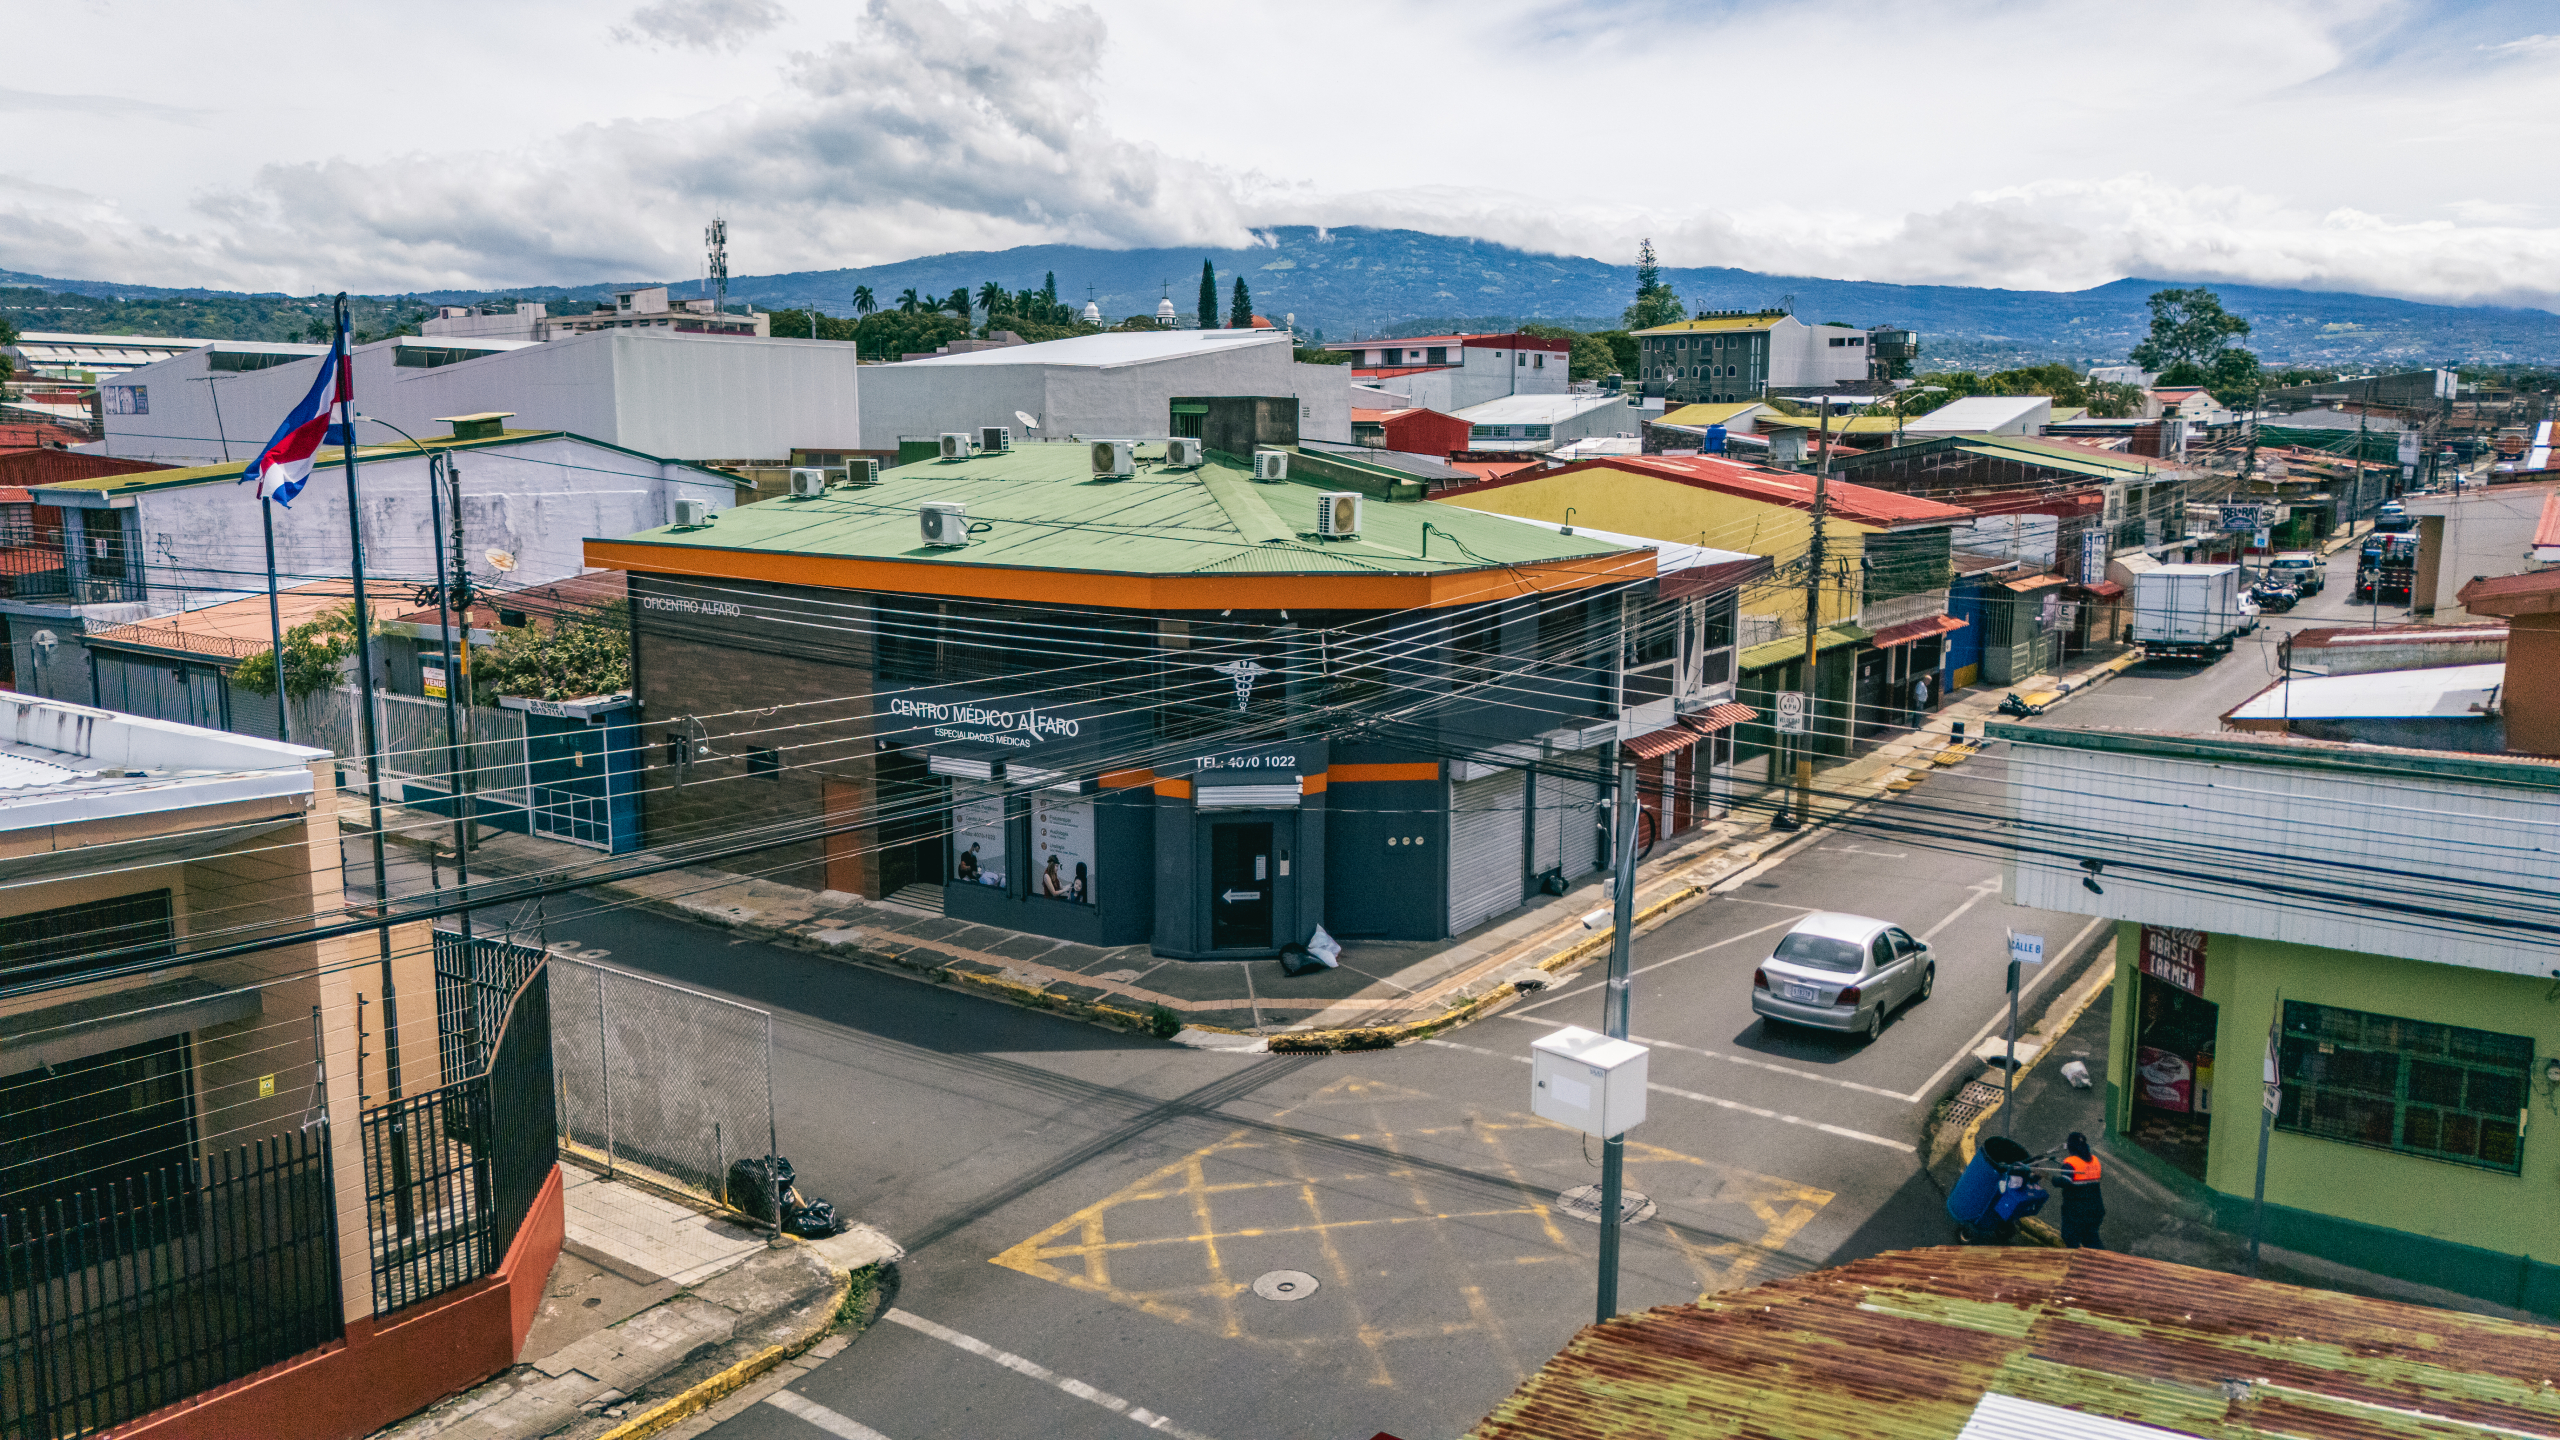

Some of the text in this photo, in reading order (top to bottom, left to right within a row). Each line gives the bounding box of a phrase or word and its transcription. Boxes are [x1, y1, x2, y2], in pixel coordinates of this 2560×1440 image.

[643, 596, 741, 617] OFICENTRO ALFARO
[539, 701, 560, 709] VENDE
[891, 698, 1079, 741] CENTRO MÉDICO ALFARO
[934, 727, 1031, 748] ESPECIALIDADES MÉDICAS
[1227, 756, 1260, 768] 4070
[1265, 755, 1296, 768] 1022
[2012, 940, 2033, 953] CALLE
[2149, 954, 2196, 991] CARMEN
